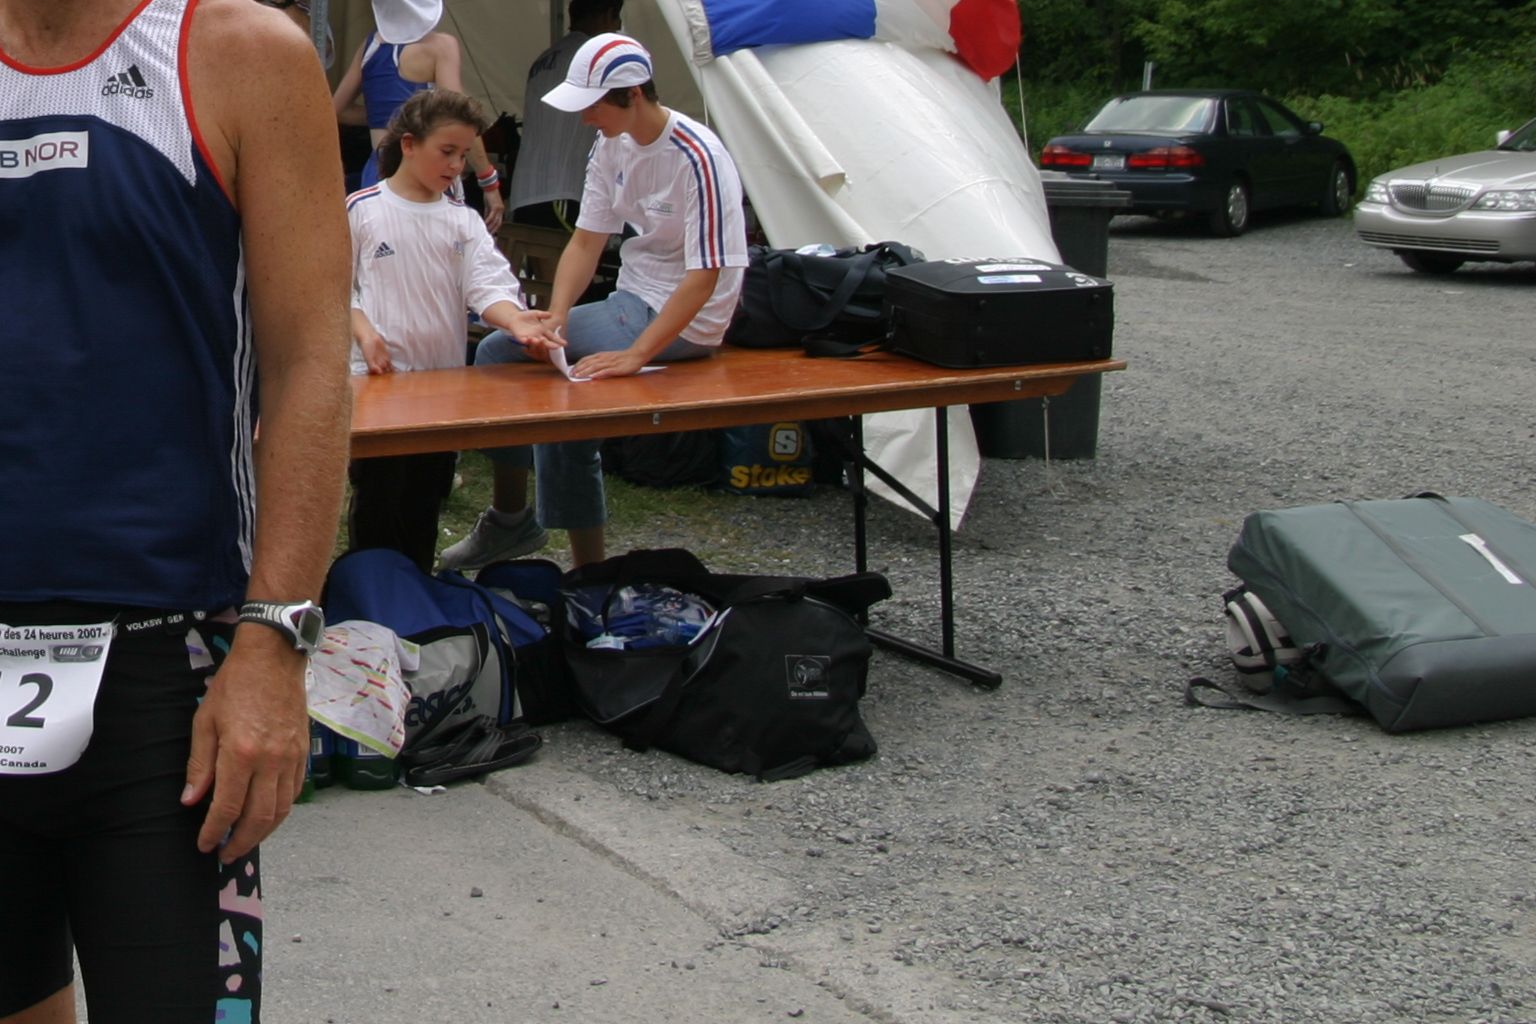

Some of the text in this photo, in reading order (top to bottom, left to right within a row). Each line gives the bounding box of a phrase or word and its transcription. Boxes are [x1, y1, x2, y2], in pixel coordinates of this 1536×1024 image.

[102, 81, 154, 99] adidas
[4, 628, 22, 641] des
[24, 628, 36, 641] 24
[39, 628, 74, 641] heures
[0, 758, 48, 768] Canada
